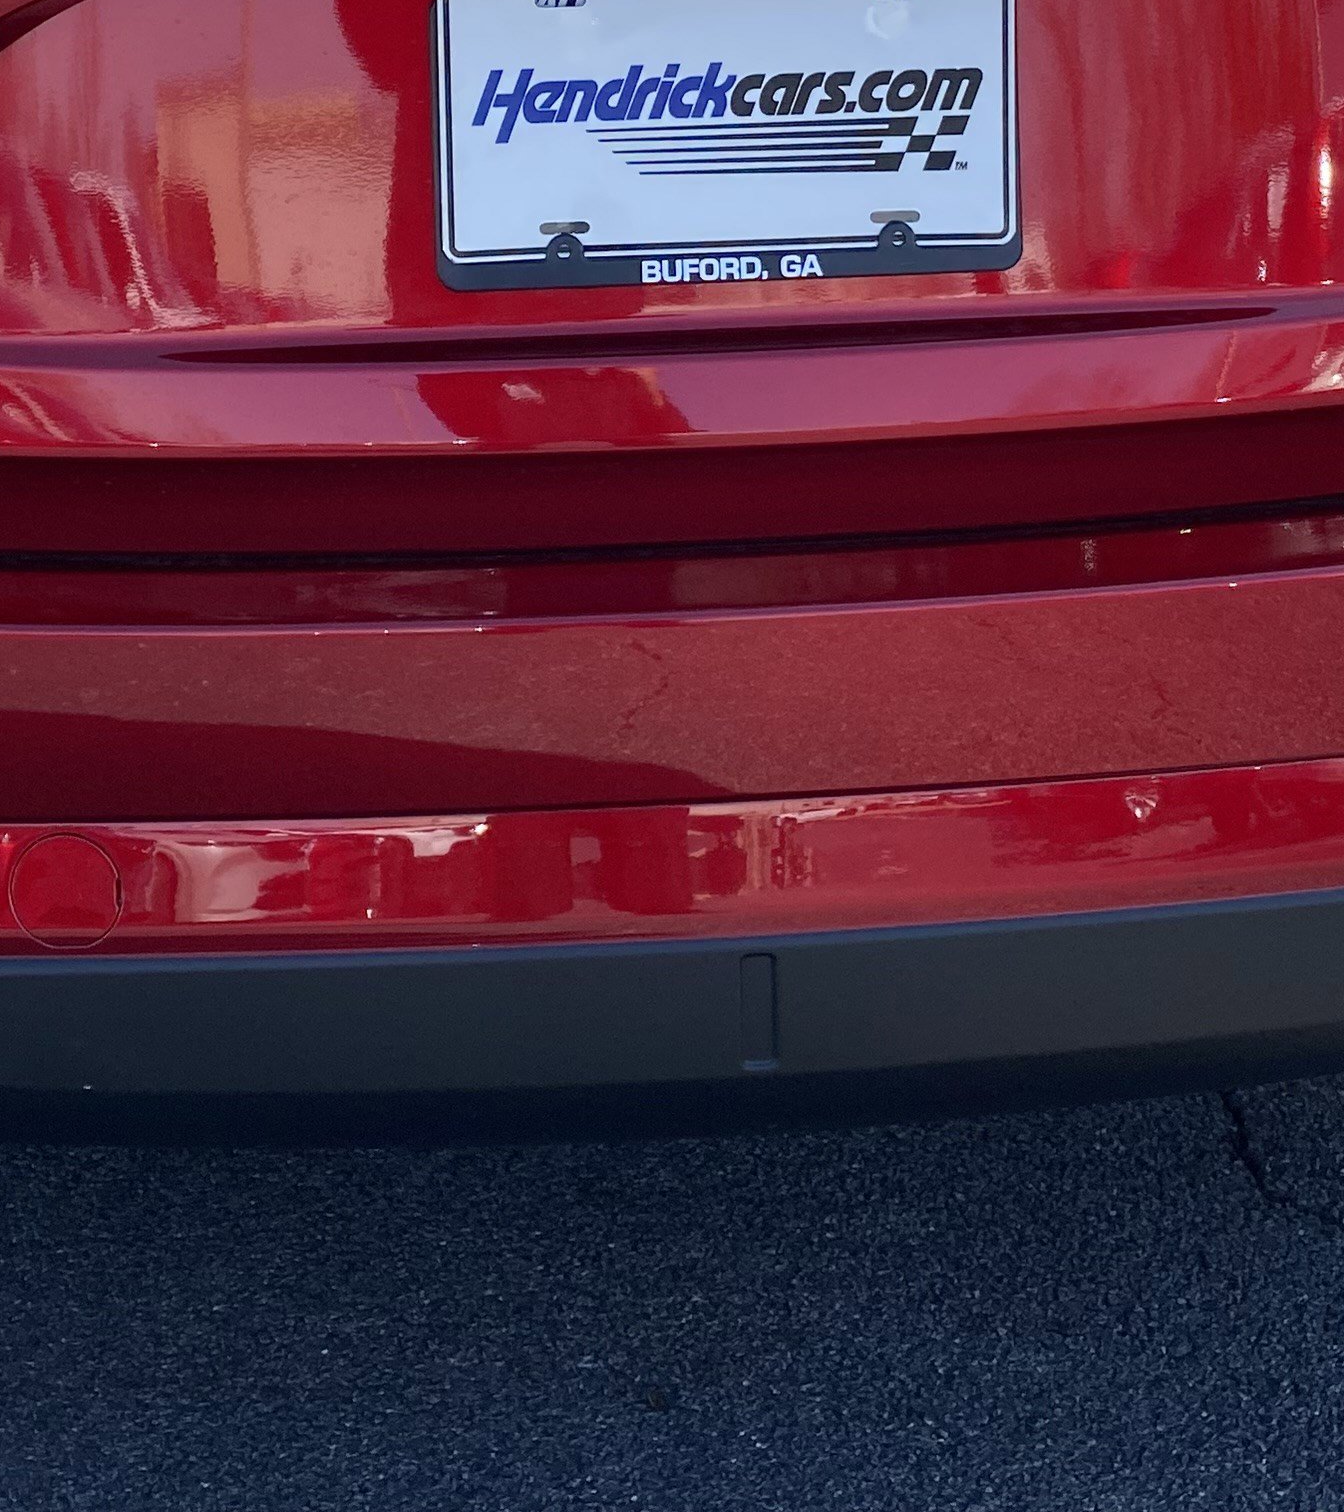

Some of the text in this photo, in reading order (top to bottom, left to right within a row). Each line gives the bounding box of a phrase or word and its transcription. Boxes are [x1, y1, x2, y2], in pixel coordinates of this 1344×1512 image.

[472, 61, 984, 144] Hendrickcars.com
[641, 254, 824, 284] BUFORD, GA
